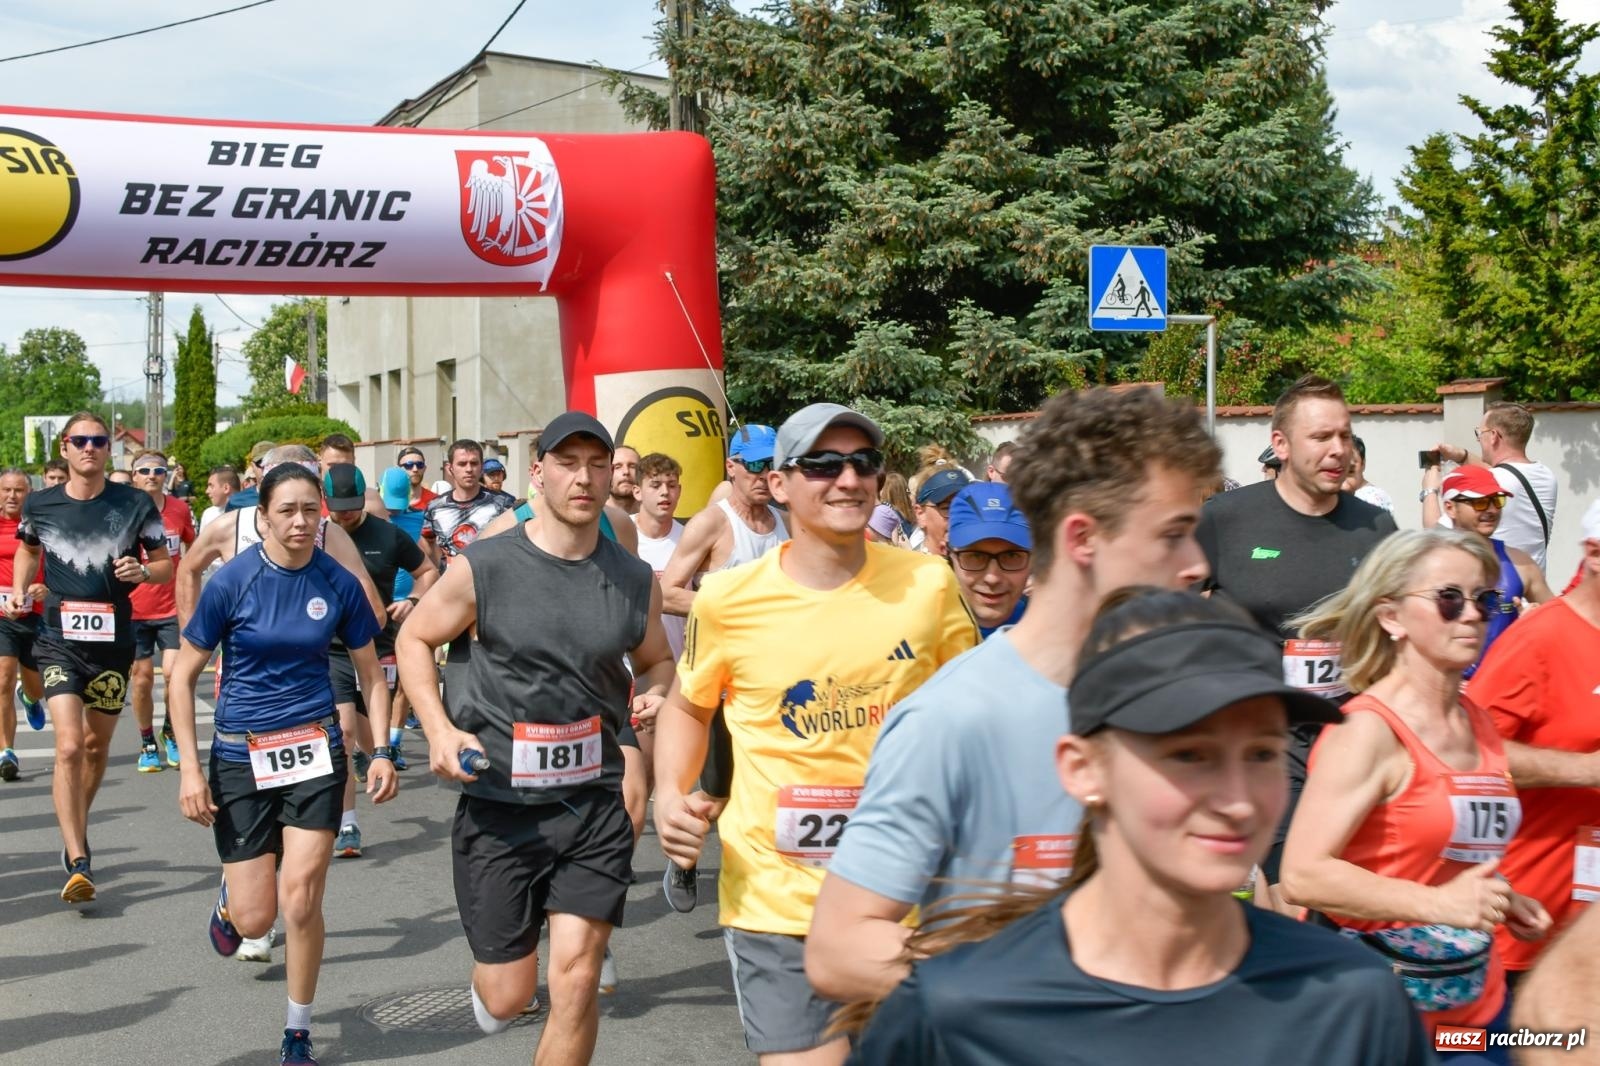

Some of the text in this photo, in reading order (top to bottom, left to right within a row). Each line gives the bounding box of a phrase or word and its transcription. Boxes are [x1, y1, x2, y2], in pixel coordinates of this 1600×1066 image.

[207, 140, 323, 169] BIEG
[119, 182, 412, 222] BEZ GRANIC
[140, 231, 387, 269] RACIBÓRZ
[71, 614, 103, 631] 210
[1304, 659, 1342, 685] 12
[801, 707, 866, 735] WORLD
[266, 743, 315, 773] 195
[536, 742, 583, 770] 181
[798, 813, 850, 848] 22
[1469, 801, 1508, 839] 175
